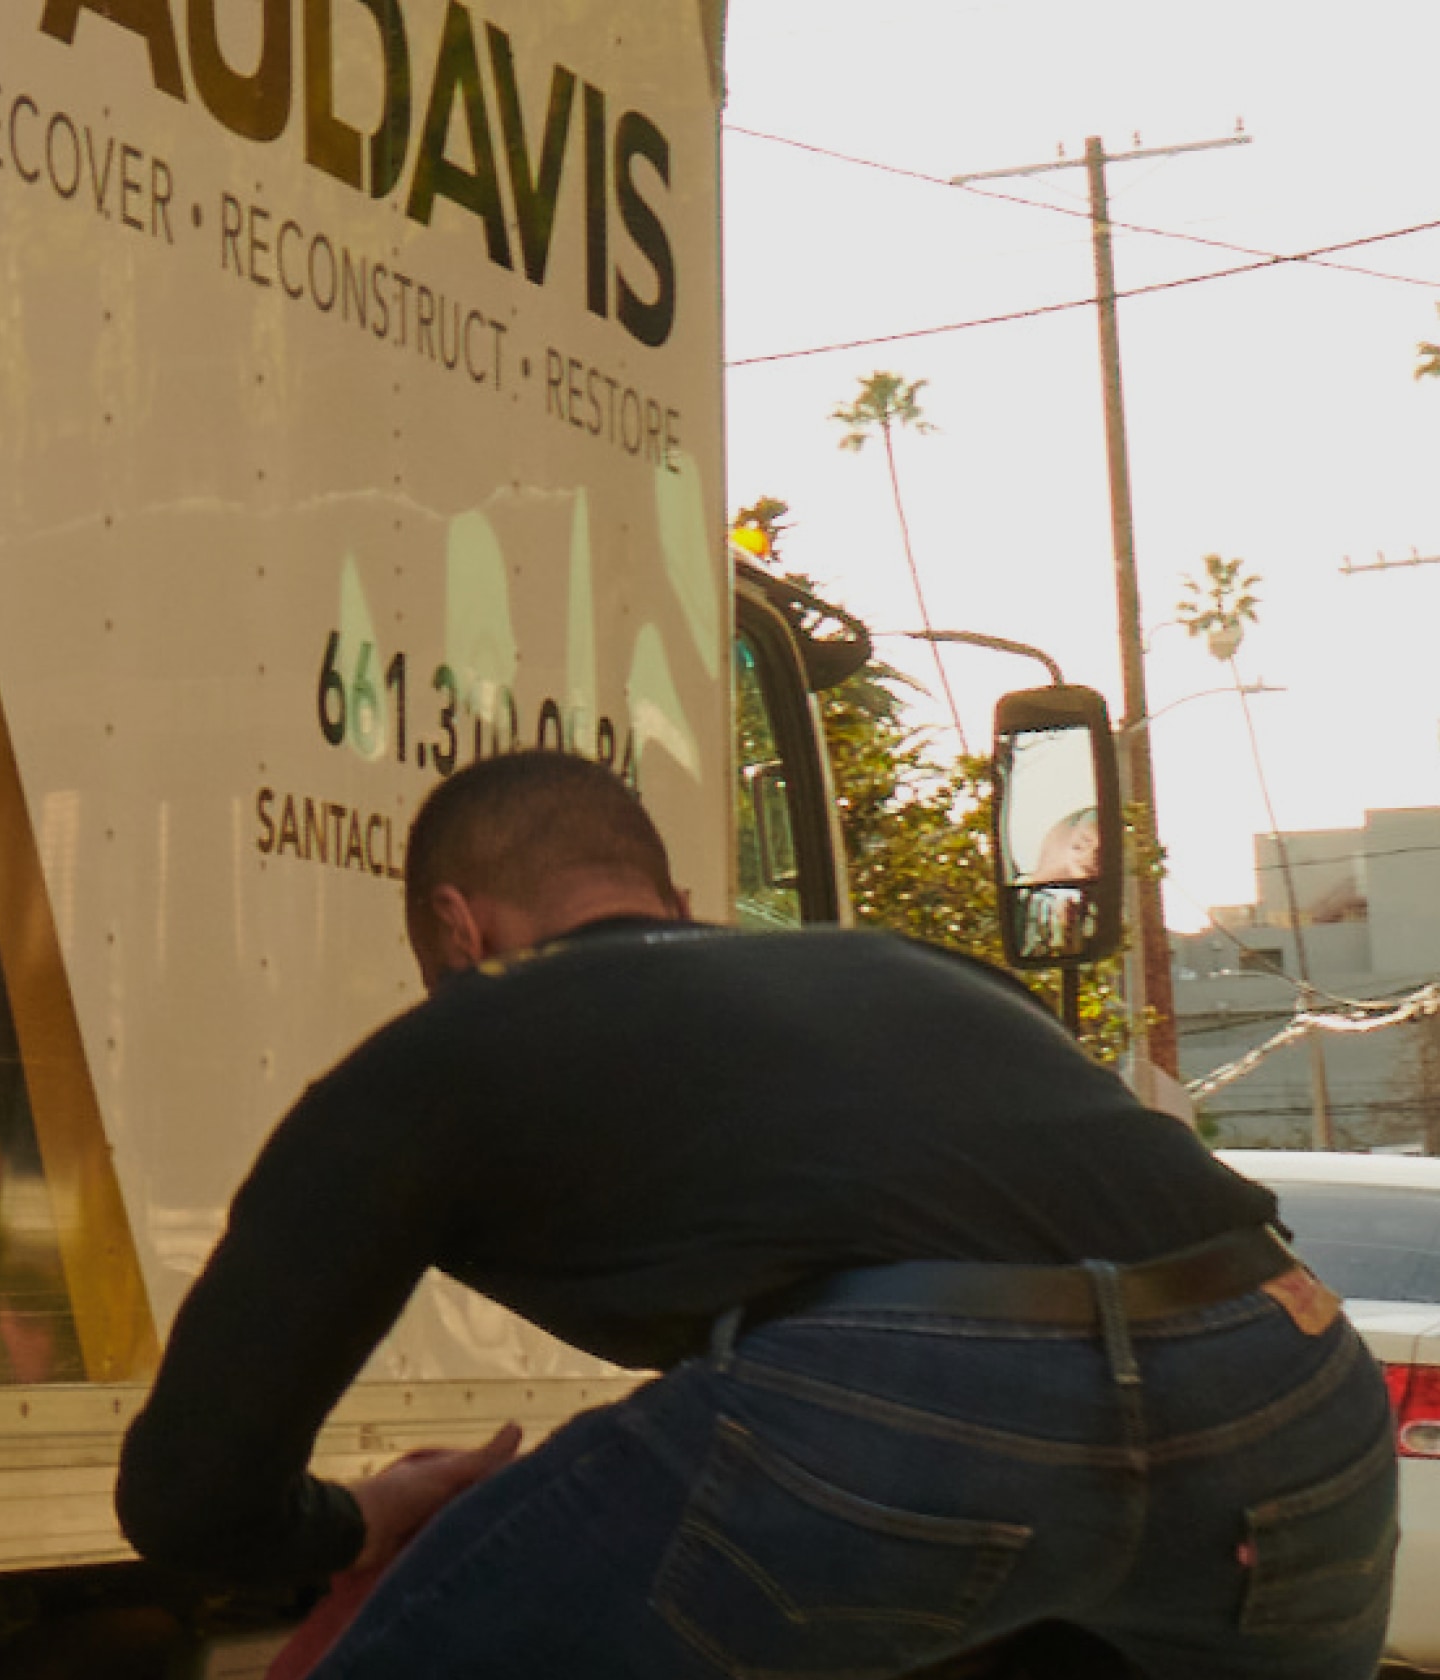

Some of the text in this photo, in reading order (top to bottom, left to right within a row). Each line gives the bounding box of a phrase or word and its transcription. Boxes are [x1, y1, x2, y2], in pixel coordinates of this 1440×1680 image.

[221, 191, 507, 391] RECONSTRUCT
[546, 347, 681, 474] RESTORE
[257, 787, 406, 881] SANTACL
